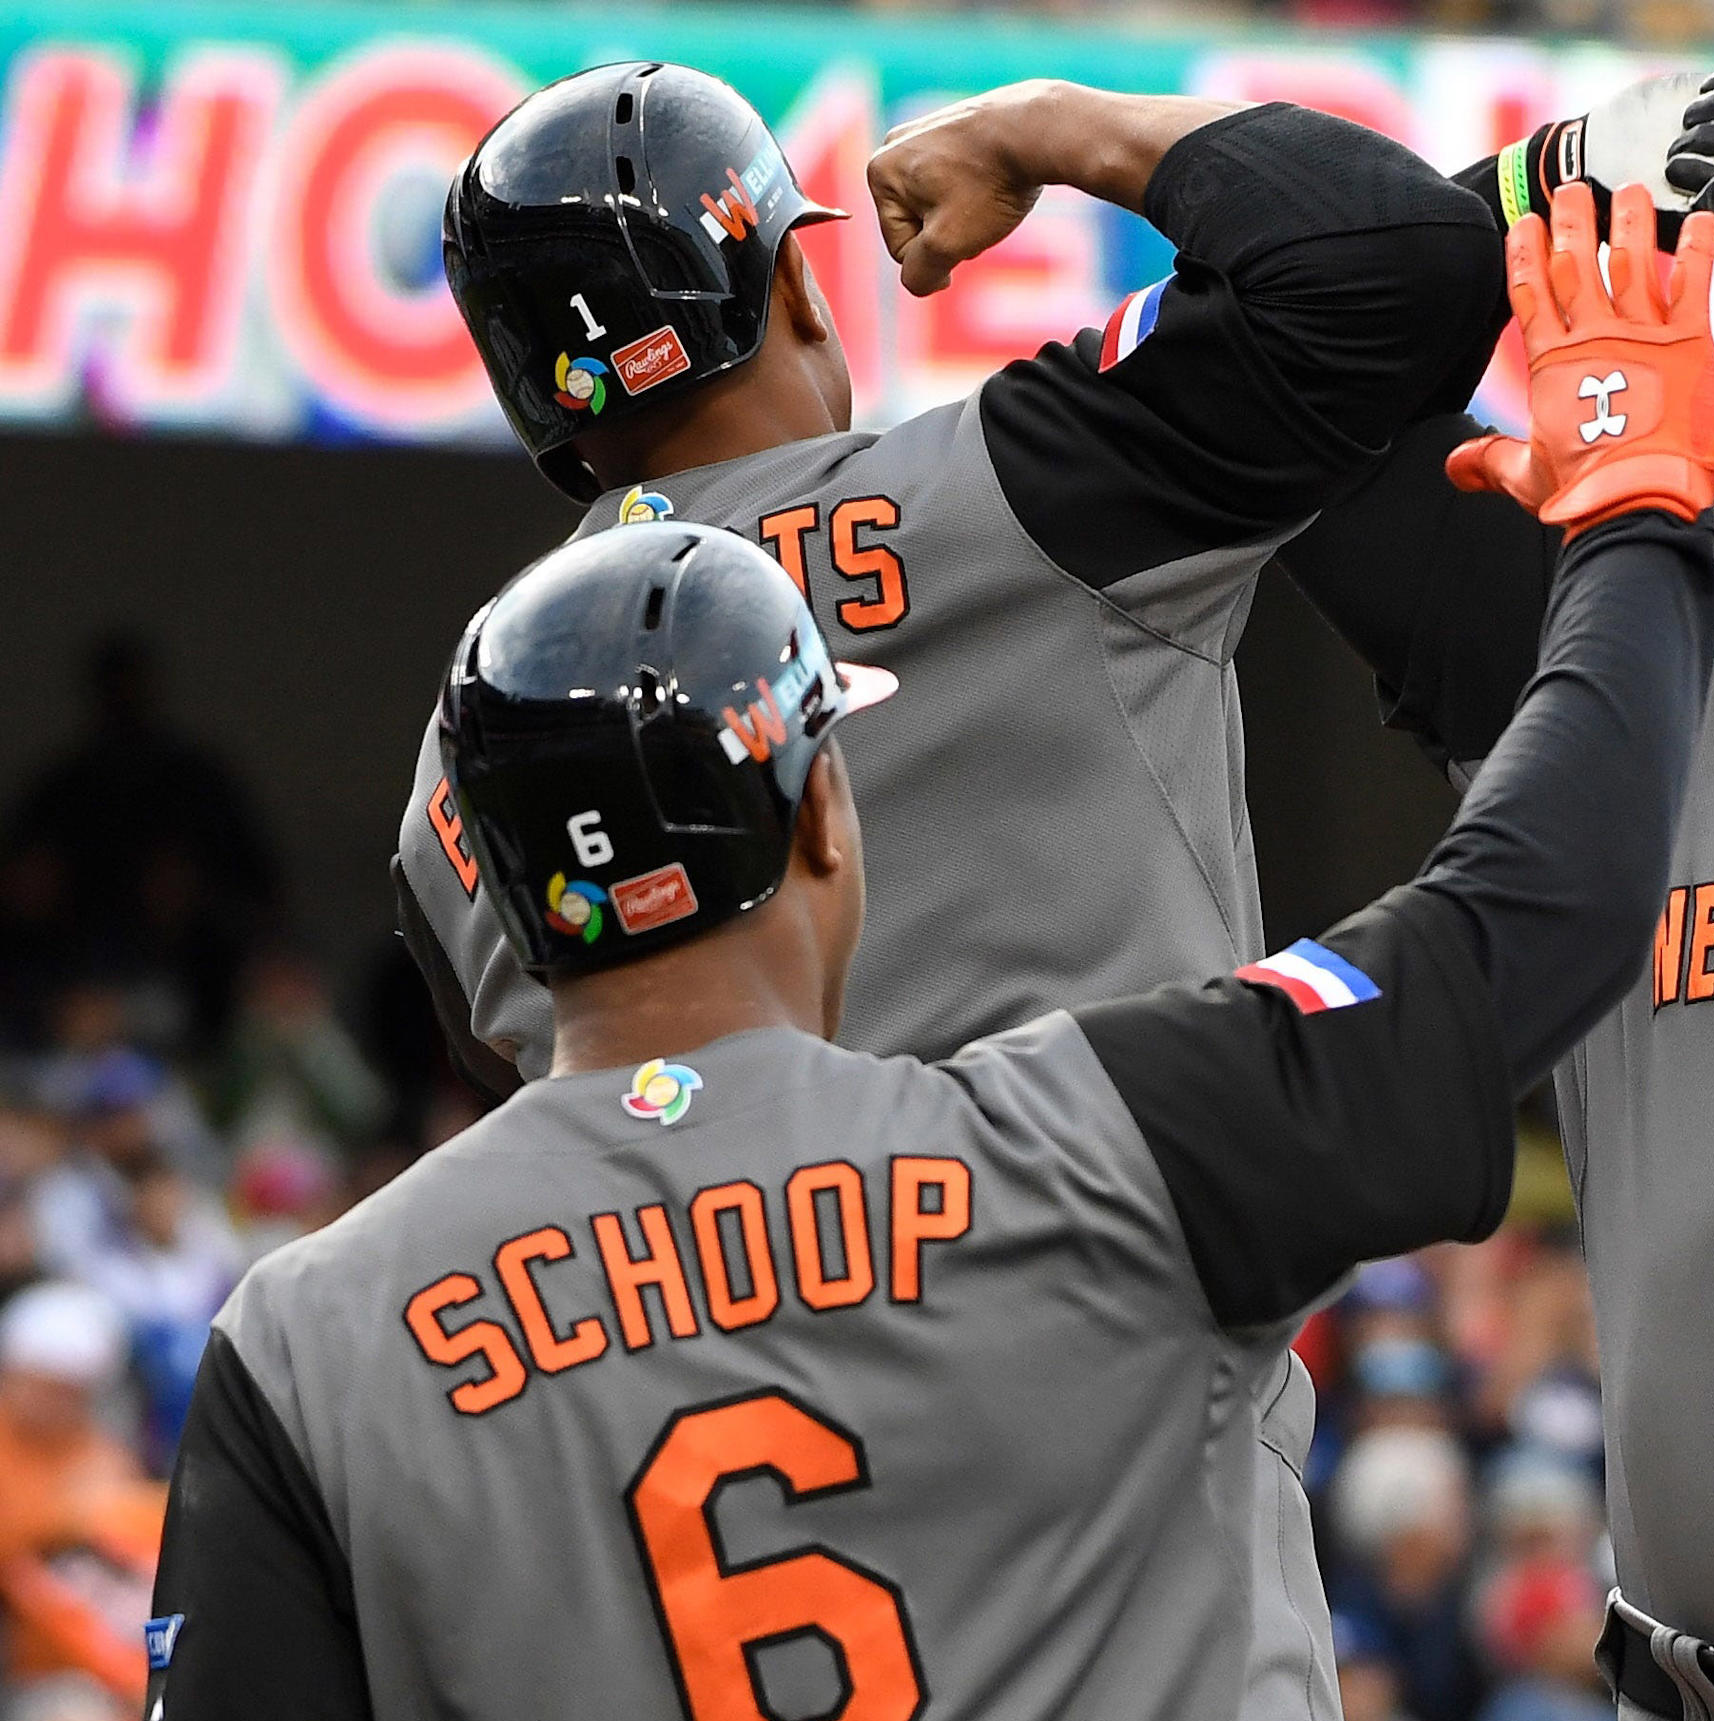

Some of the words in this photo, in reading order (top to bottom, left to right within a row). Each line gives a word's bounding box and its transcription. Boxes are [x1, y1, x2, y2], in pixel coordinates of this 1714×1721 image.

[570, 292, 607, 342] 1
[624, 340, 673, 379] Rawlings
[566, 809, 614, 868] 6
[403, 1154, 973, 1416] SCHOOP
